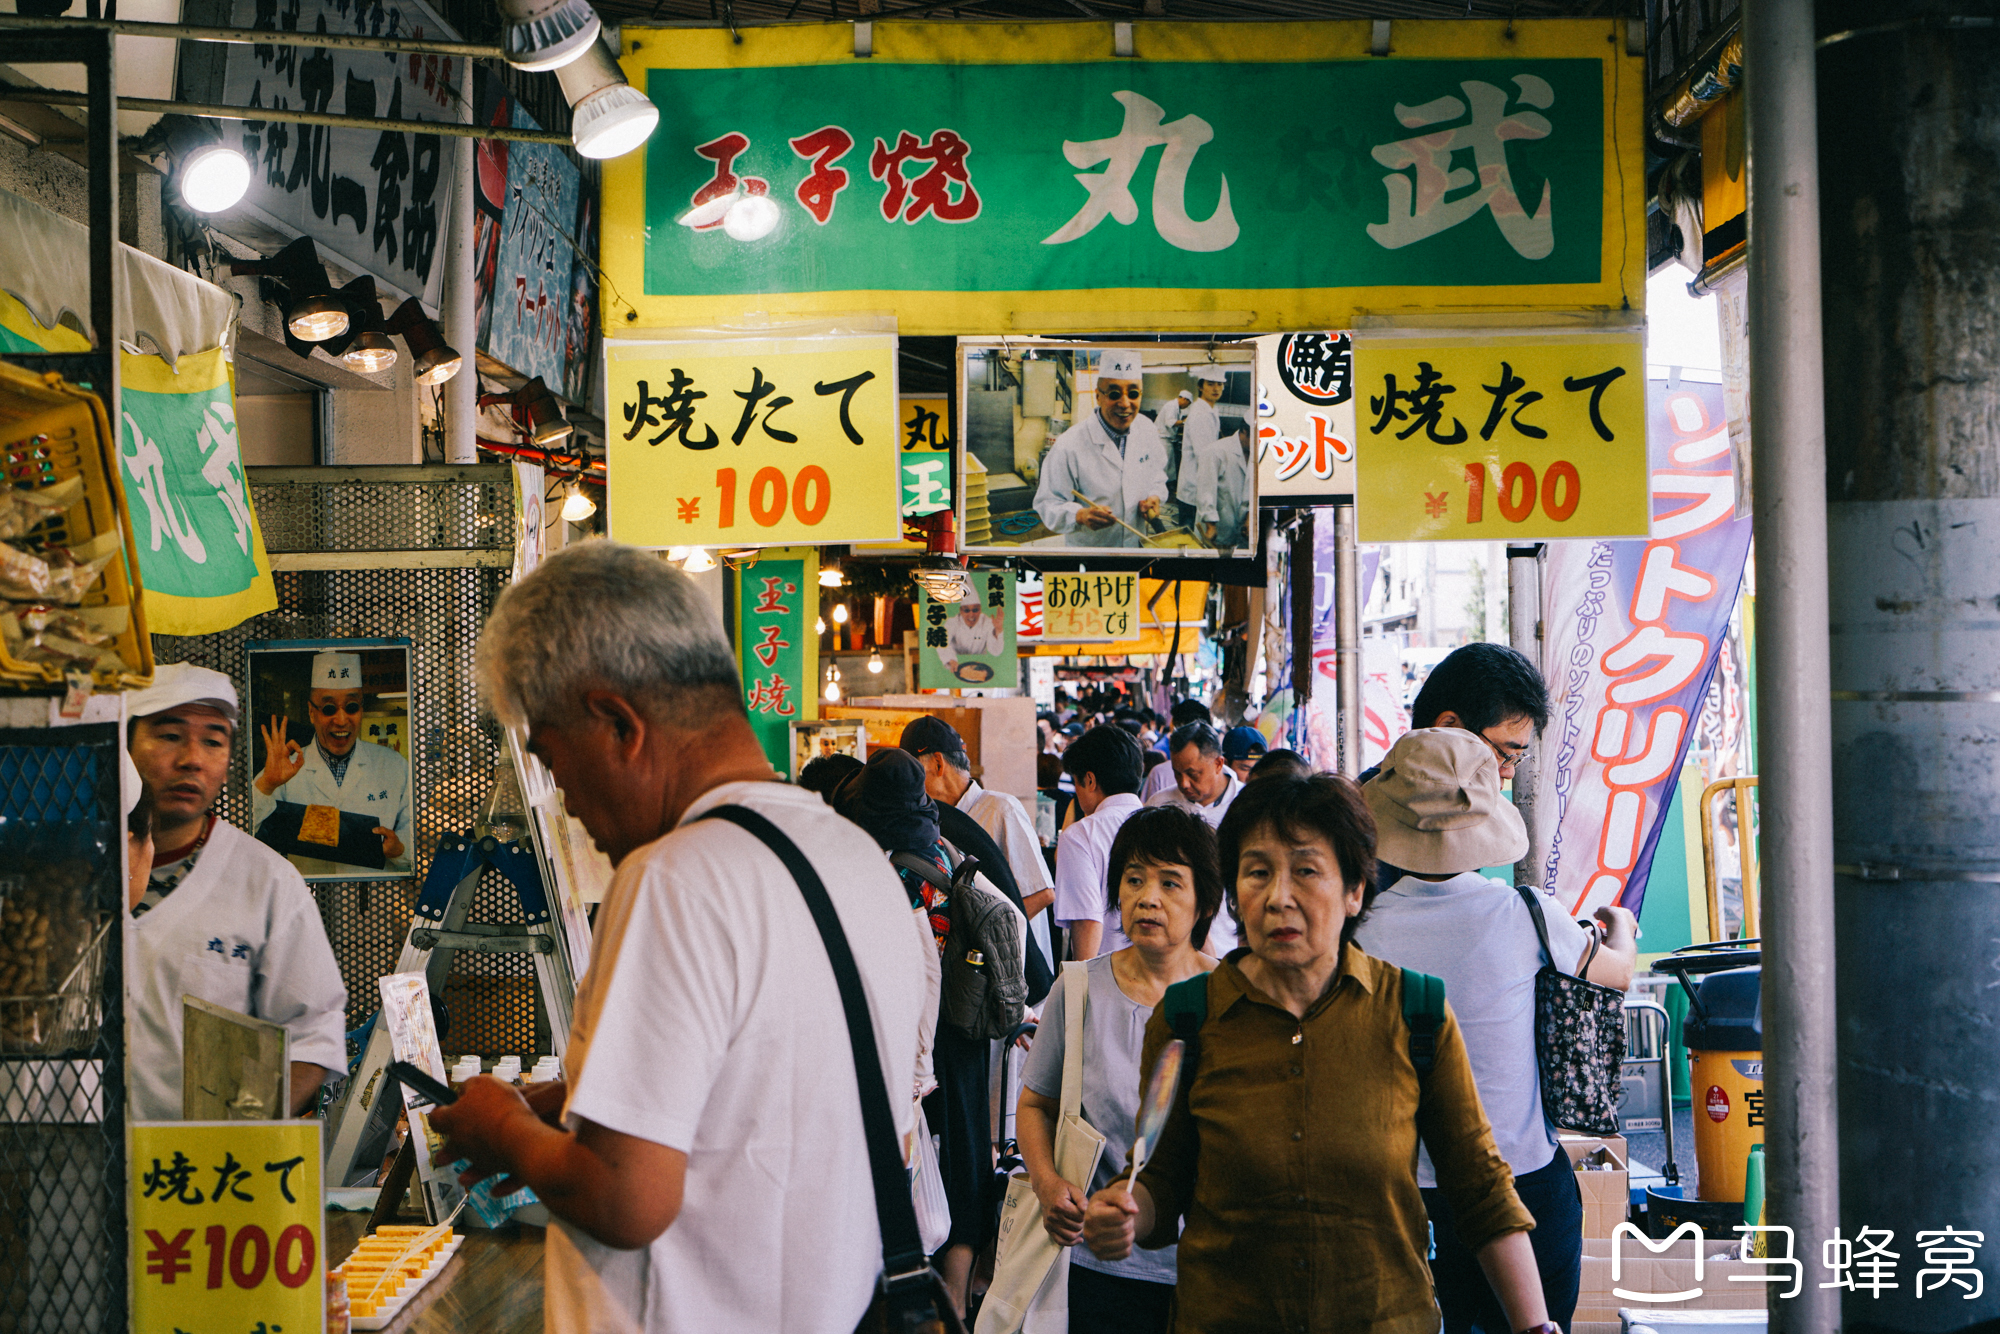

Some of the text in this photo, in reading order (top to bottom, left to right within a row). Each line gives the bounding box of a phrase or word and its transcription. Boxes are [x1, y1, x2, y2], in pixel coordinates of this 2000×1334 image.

[677, 73, 1556, 261] 玉子焼 丸武
[508, 185, 555, 274] フィッシュ
[515, 273, 562, 353] マーケット
[622, 366, 876, 450] 焼たて
[1369, 360, 1627, 446] 焼たて
[676, 465, 831, 529] ¥100
[1424, 460, 1582, 524] ¥100
[1047, 576, 1135, 608] おみやげ
[748, 576, 797, 716] 玉子焼
[143, 1151, 305, 1205] 焼たて
[143, 1223, 316, 1290] ¥100
